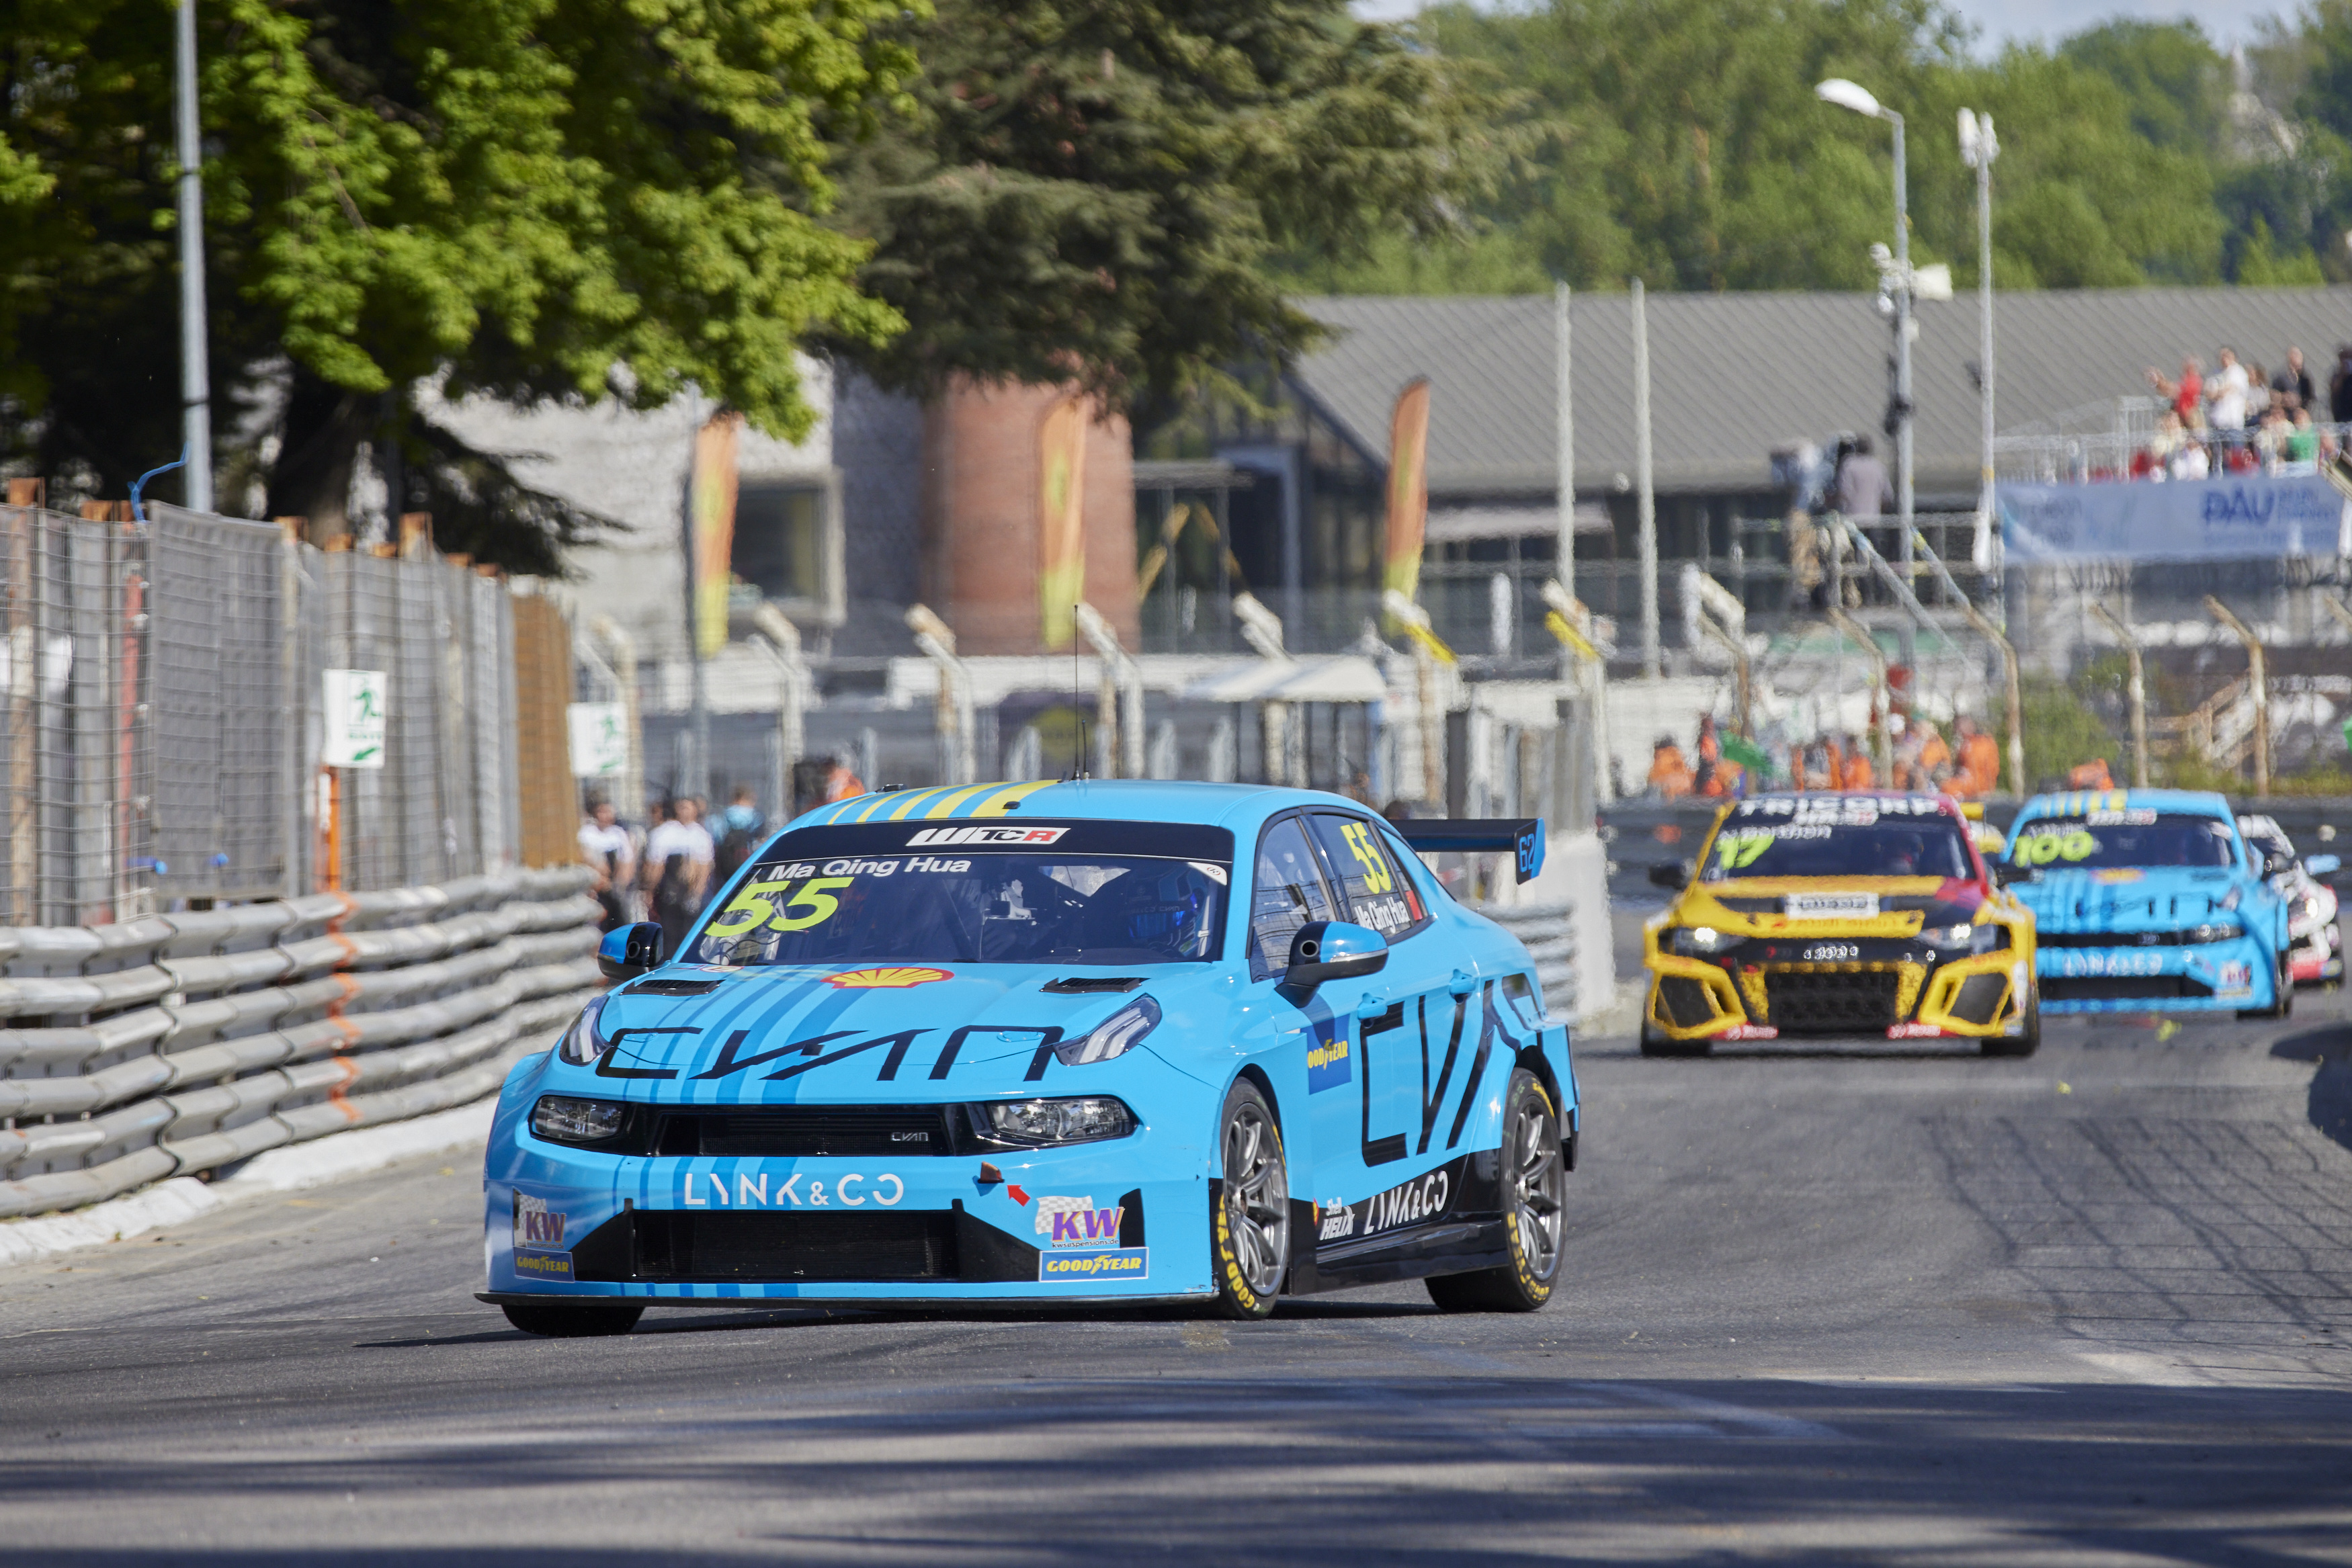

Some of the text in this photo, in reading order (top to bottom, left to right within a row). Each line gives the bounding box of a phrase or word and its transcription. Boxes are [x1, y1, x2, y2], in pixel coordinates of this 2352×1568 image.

[905, 826, 1071, 846] WTCR
[2014, 830, 2093, 868] 100
[1340, 822, 1391, 894] 55
[1519, 833, 1535, 873] 62
[1716, 834, 1775, 870] 17
[767, 857, 972, 881] Ma Qing Hua
[704, 877, 855, 937] 55
[1386, 896, 1411, 925] Hua
[1307, 1039, 1348, 1069] OODYEAR
[1326, 1197, 1343, 1217] Shell
[526, 1211, 567, 1244] KW
[1051, 1207, 1126, 1242] KW
[1319, 1207, 1355, 1241] HELIX
[1052, 1239, 1120, 1249] kwsuspensions.de
[517, 1256, 570, 1273] GOODYEAR
[1046, 1256, 1142, 1274] GOODYEAR
